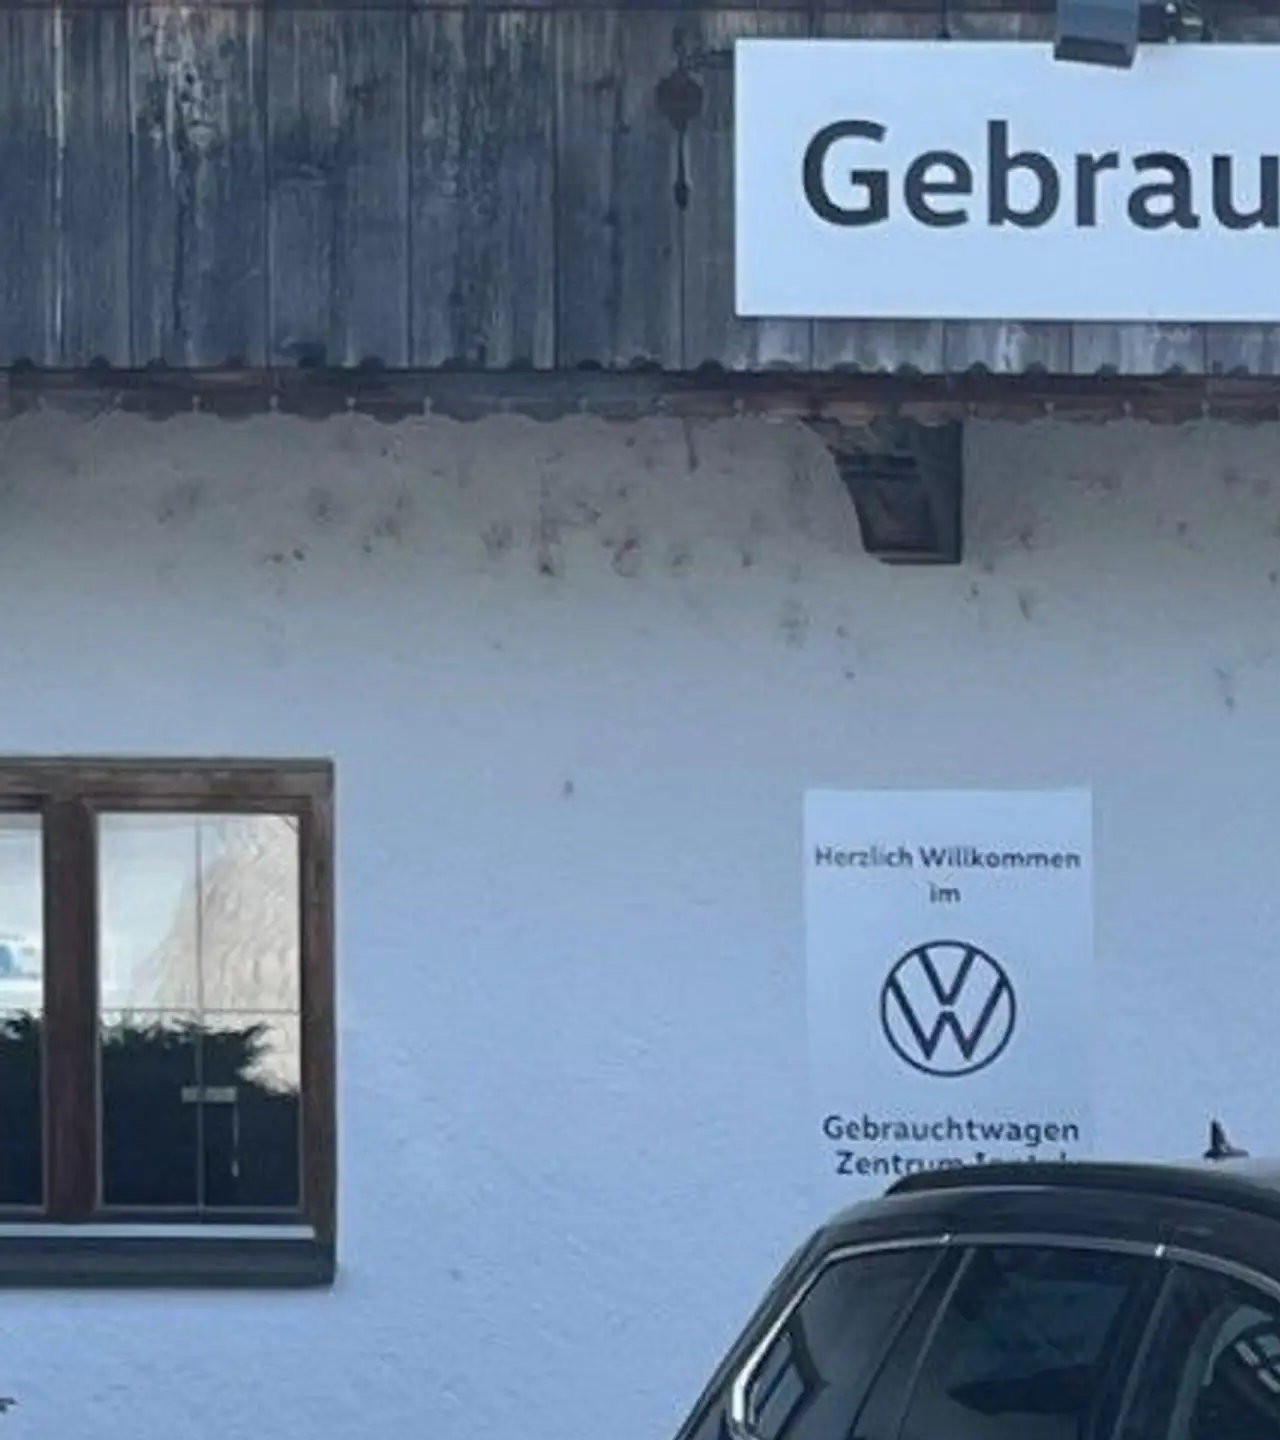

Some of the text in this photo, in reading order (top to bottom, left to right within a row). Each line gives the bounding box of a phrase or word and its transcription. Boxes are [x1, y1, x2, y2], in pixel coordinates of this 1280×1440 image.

[815, 846, 1081, 869] Herzlich Willkommen
[929, 882, 961, 903] im
[822, 1114, 1079, 1147] Gebrauchtwagen
